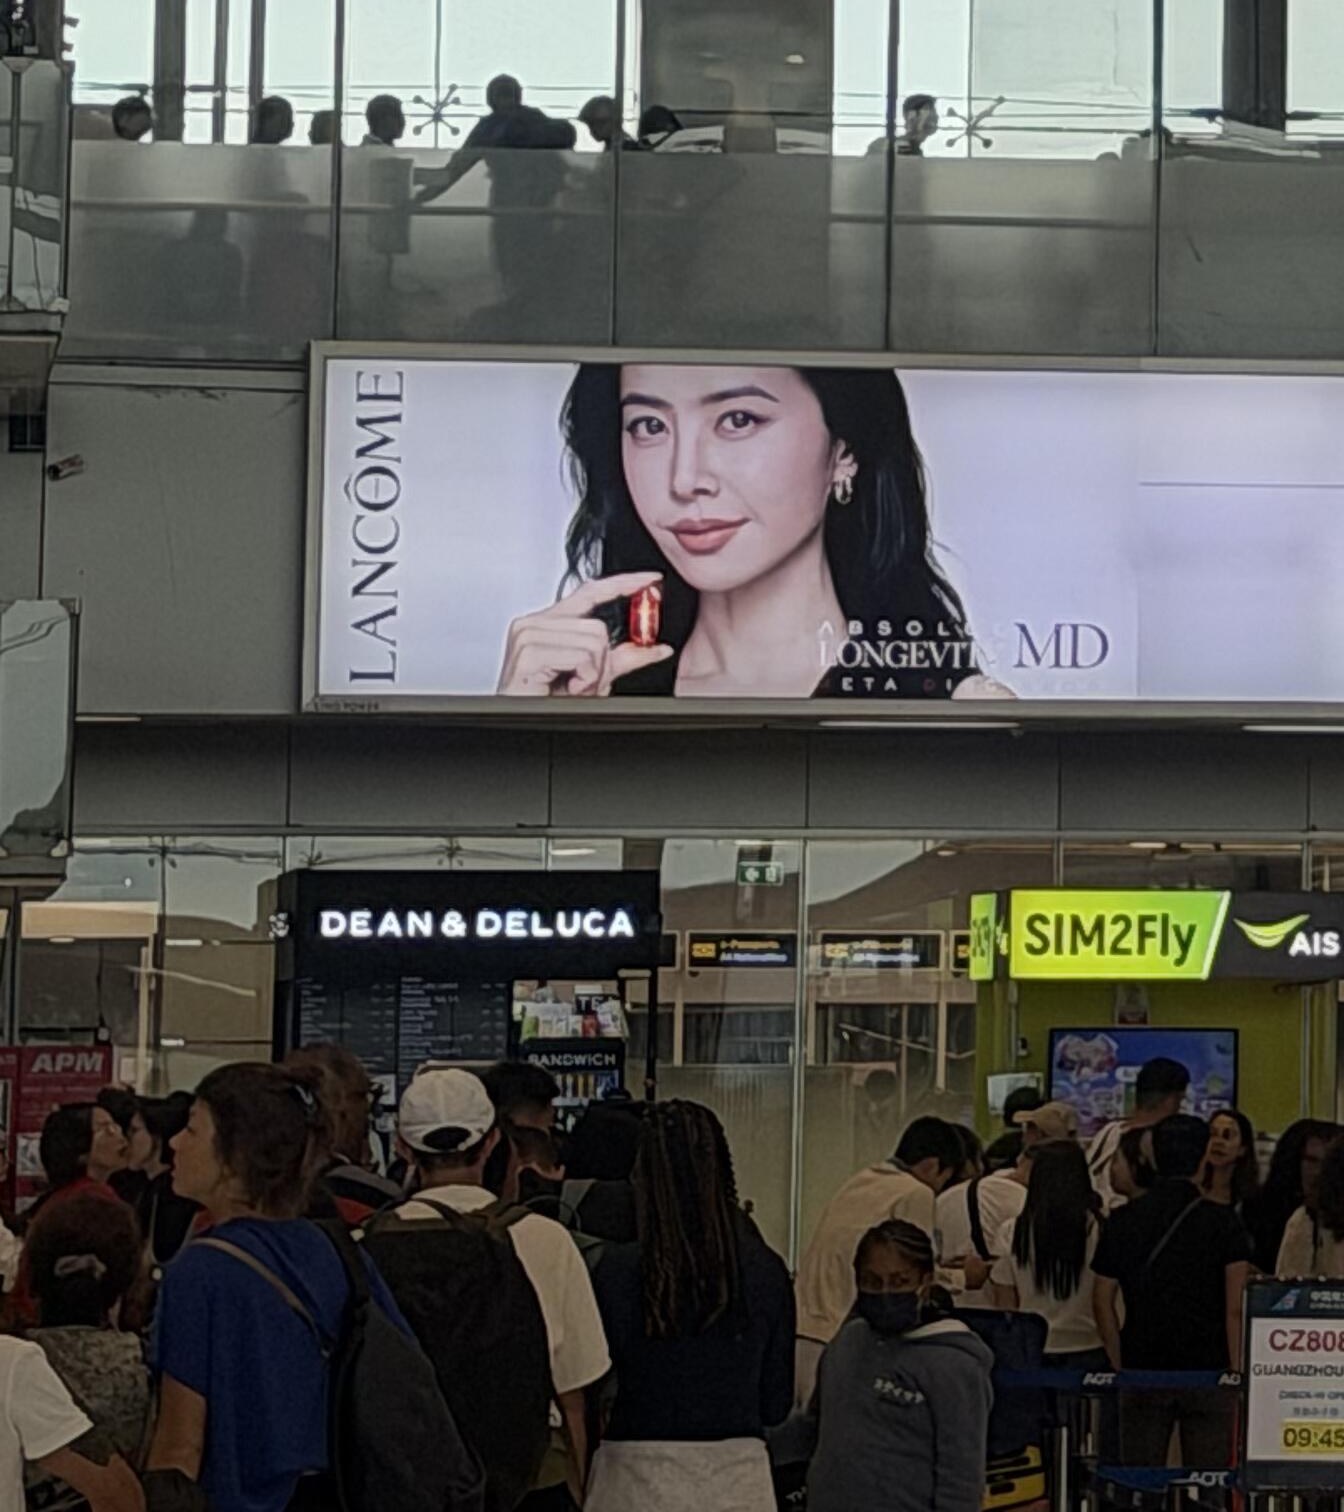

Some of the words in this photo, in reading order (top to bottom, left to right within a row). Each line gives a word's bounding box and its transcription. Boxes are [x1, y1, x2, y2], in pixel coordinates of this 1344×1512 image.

[342, 369, 405, 685] LANCÔME
[1012, 621, 1110, 670] MD
[319, 909, 442, 939] DEAN
[441, 909, 468, 939] &
[475, 908, 636, 939] DELUCA
[1024, 912, 1198, 968] SIM2Fly
[1288, 931, 1342, 958] AIS
[578, 996, 618, 1012] TE
[31, 1051, 105, 1073] APM
[527, 1053, 616, 1066] SANDWICH
[1082, 1372, 1117, 1385] AOT
[1218, 1371, 1241, 1385] AO
[1252, 1363, 1344, 1377] GUANGZHOU
[1187, 1471, 1229, 1487] AOT
